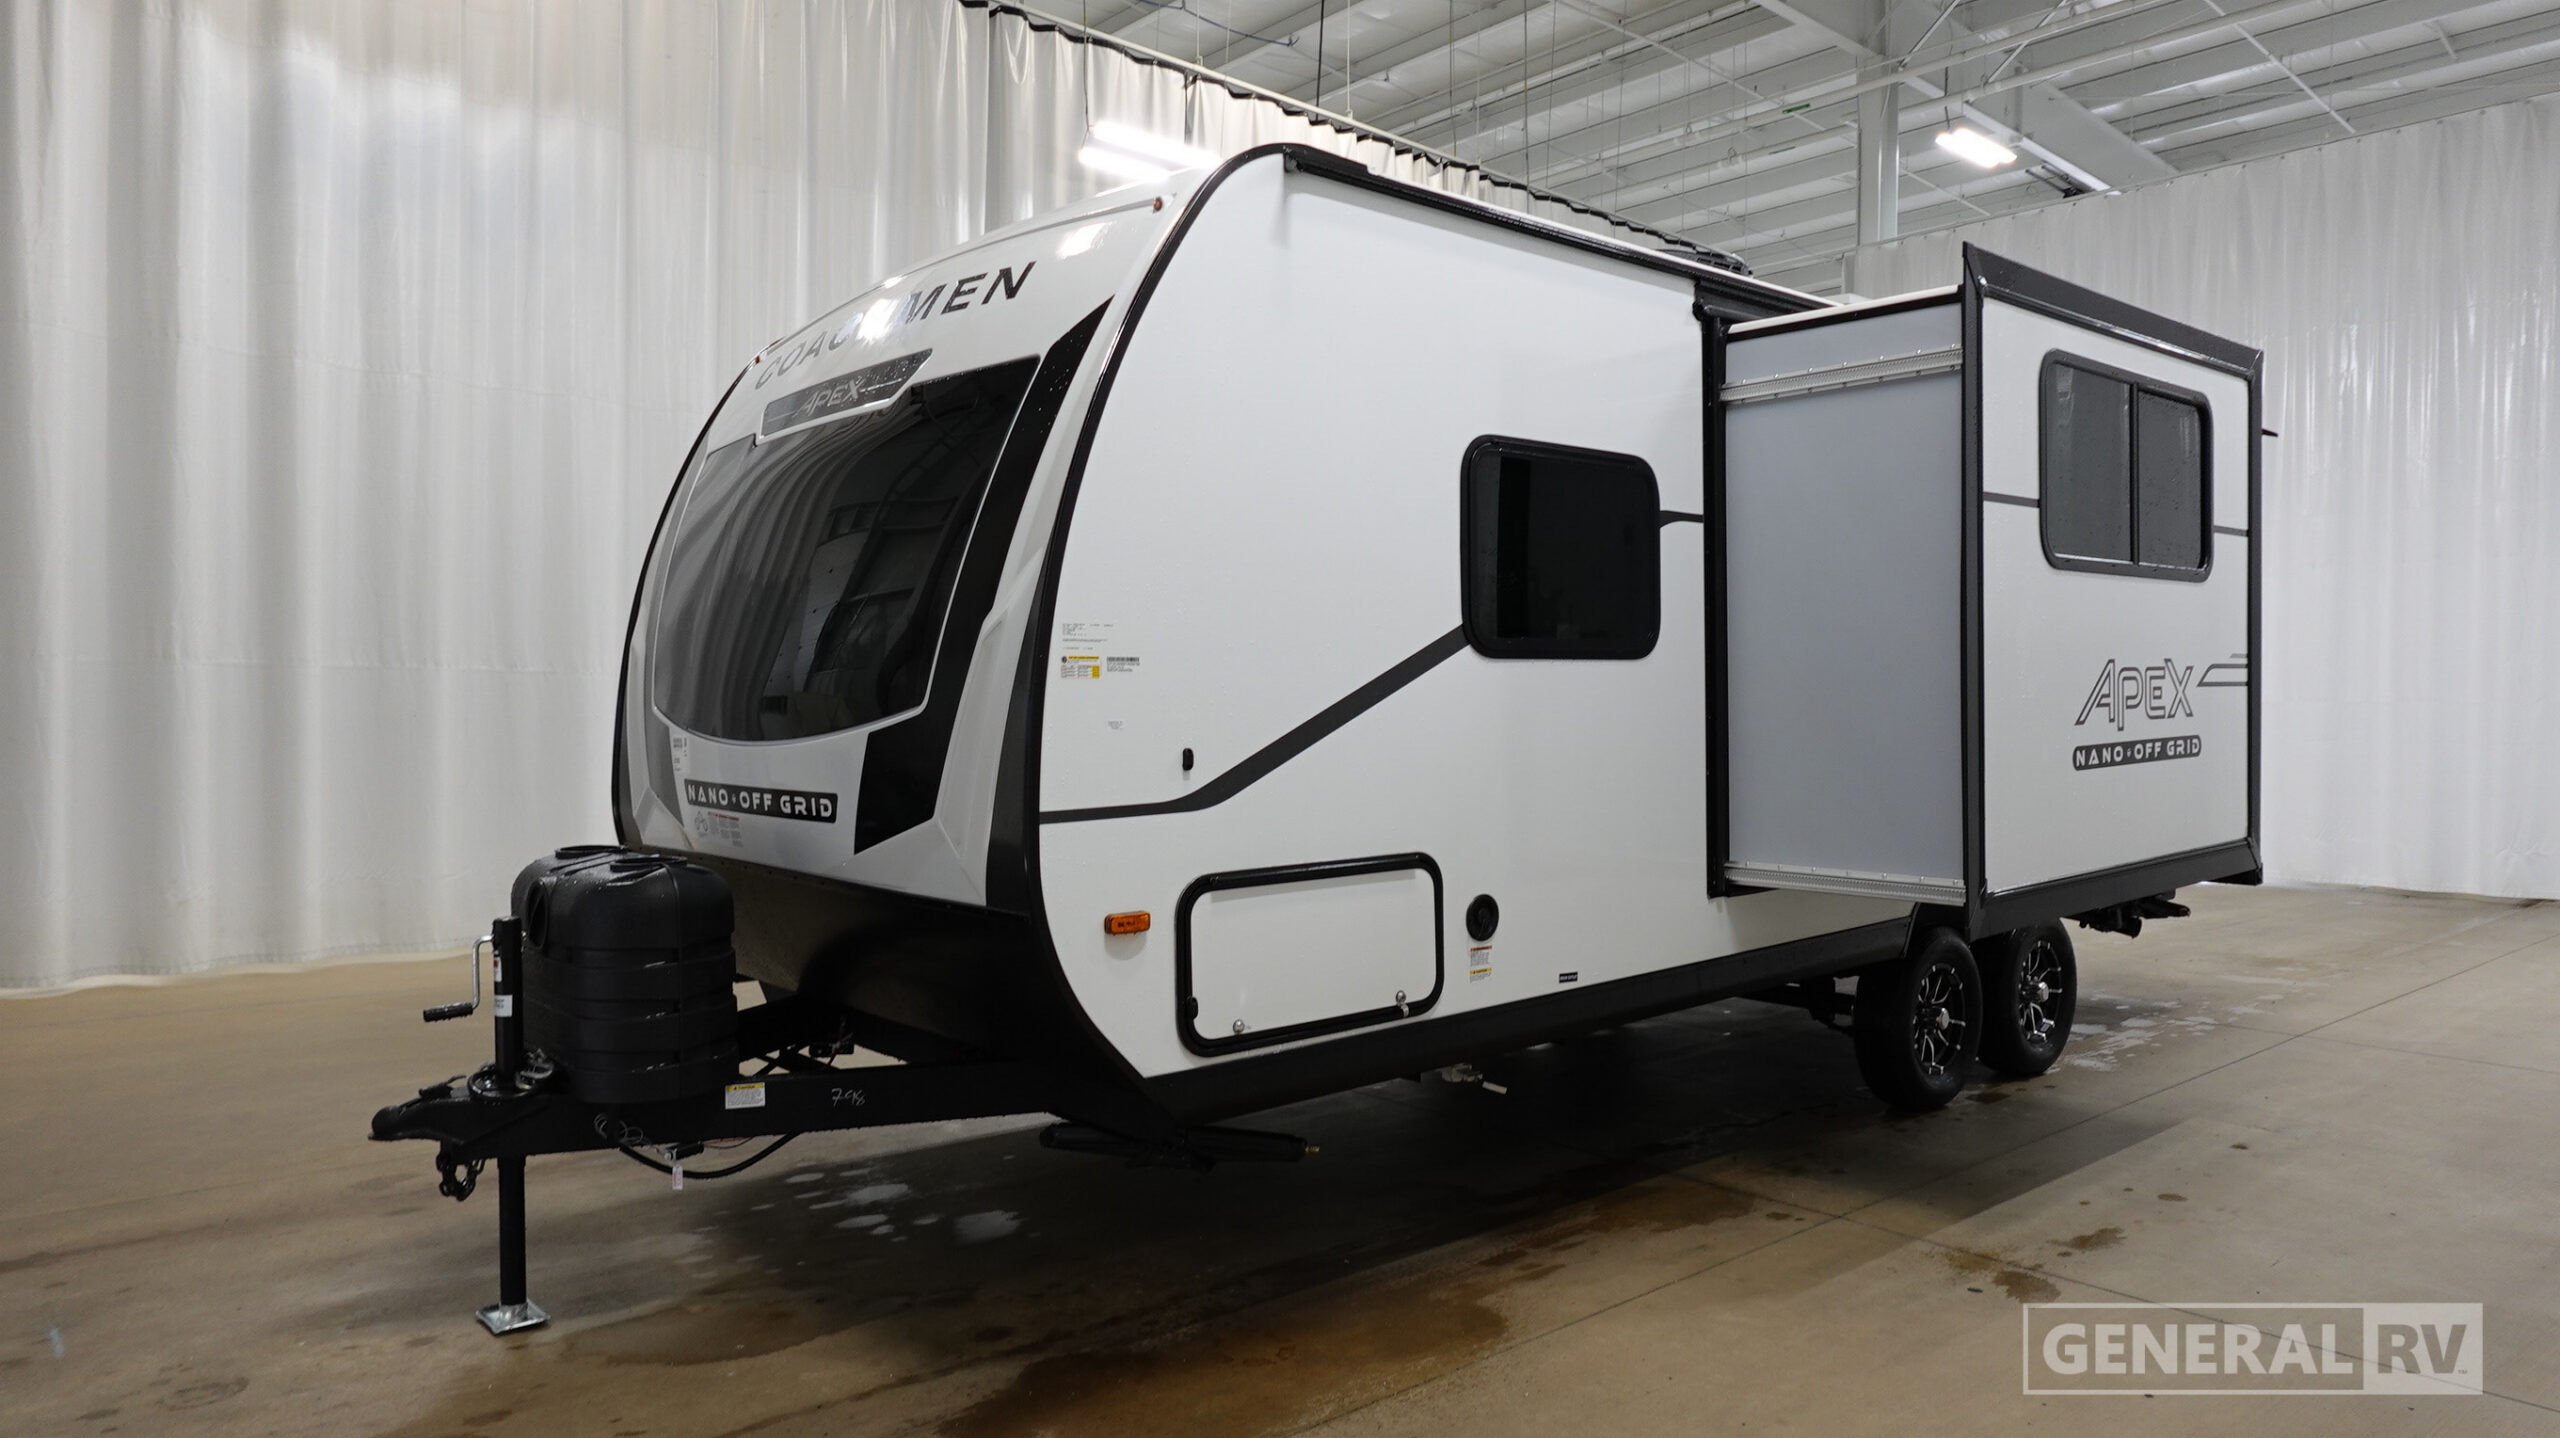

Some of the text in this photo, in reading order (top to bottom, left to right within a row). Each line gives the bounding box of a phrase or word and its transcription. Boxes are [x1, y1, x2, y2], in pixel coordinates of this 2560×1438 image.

[755, 261, 1037, 390] COACMEN
[2074, 658, 2195, 731] APEX
[2075, 737, 2200, 767] NANO OFF GRID
[687, 784, 833, 818] NANO OFF GRID
